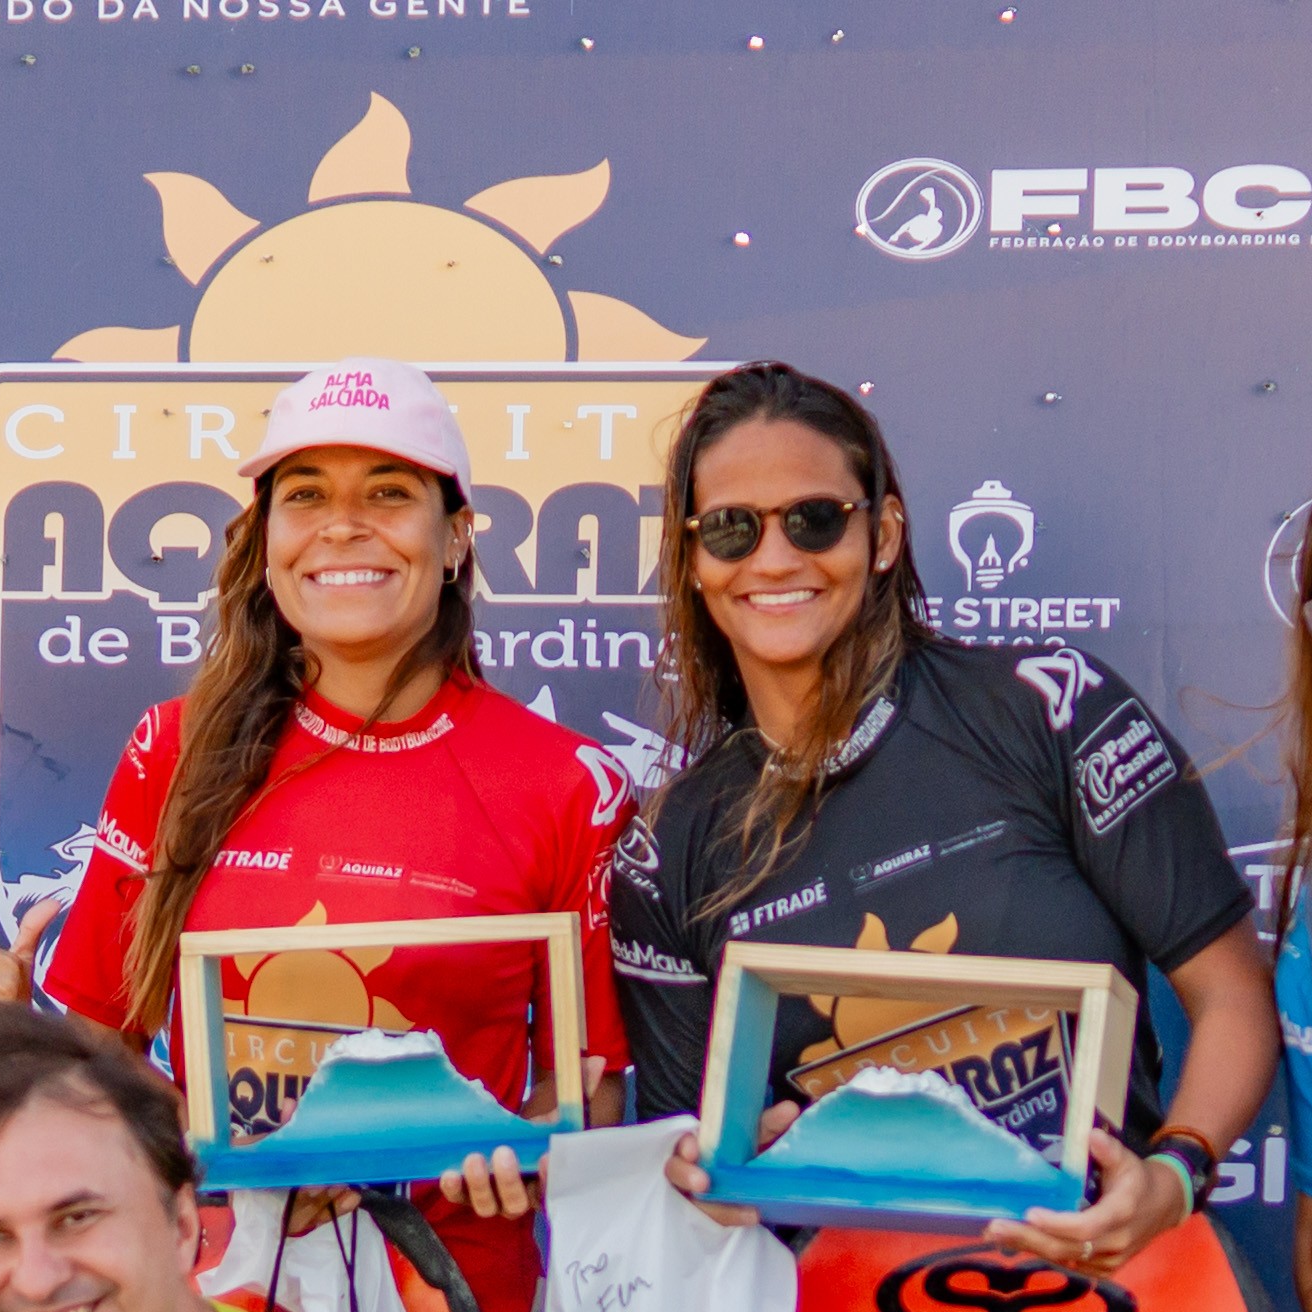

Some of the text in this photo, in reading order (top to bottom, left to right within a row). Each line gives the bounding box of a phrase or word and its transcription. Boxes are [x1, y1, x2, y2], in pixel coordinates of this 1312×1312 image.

[98, 0, 160, 20] DA
[989, 234, 1088, 250] FEDERAÇÃO
[1114, 235, 1138, 248] DE
[1147, 233, 1302, 247] BODYBOARDING
[324, 371, 373, 390] ALMA
[308, 387, 390, 412] SALGADA
[953, 596, 1121, 636] STREET
[38, 615, 130, 665] de
[1101, 719, 1151, 765] Paula
[341, 862, 404, 878] AQUIRAZ
[873, 844, 931, 877] AQUIRAZ
[753, 882, 828, 927] FTRADE
